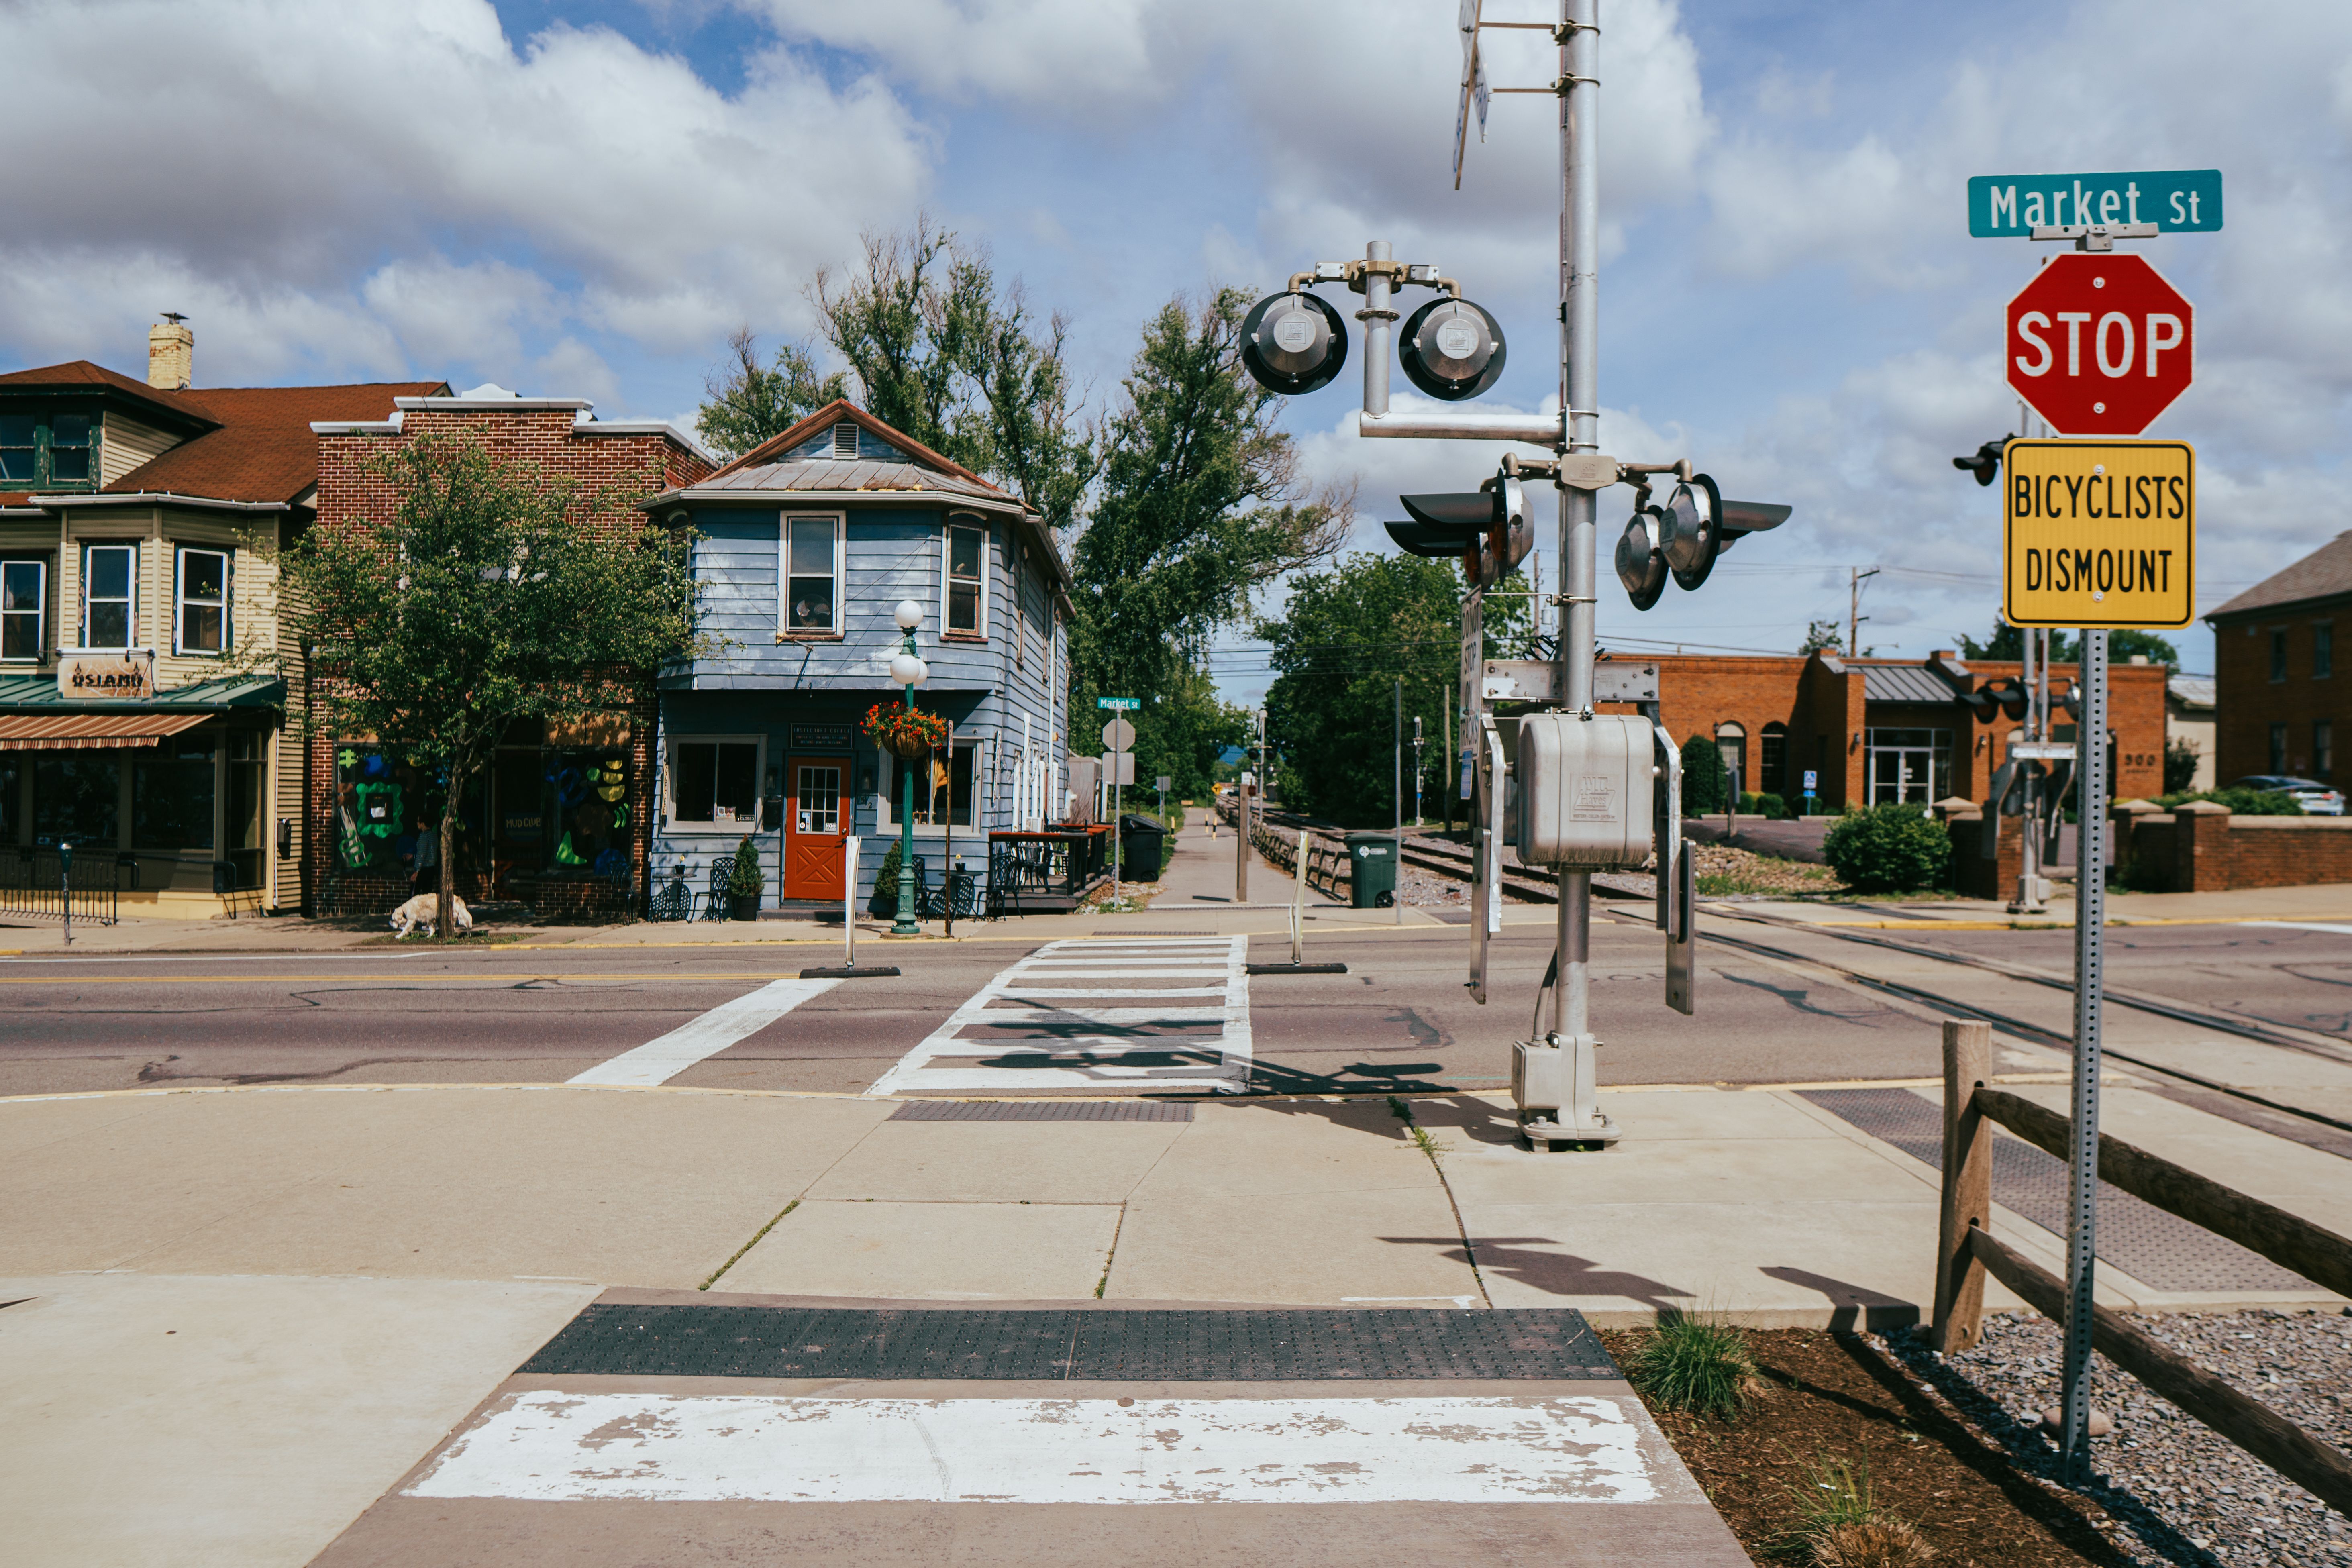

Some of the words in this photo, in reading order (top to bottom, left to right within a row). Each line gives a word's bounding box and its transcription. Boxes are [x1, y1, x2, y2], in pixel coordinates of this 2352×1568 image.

[1990, 180, 2141, 228] Market
[2170, 191, 2201, 224] St
[2015, 311, 2183, 378] STOP
[2015, 475, 2184, 519] BICYCLISTS
[2026, 549, 2172, 593] DISMOUNT
[1464, 641, 1476, 674] STOP
[85, 674, 130, 687] SIAM
[1101, 699, 1129, 708] Market
[506, 818, 523, 828] MUD
[523, 817, 541, 827] CLUB
